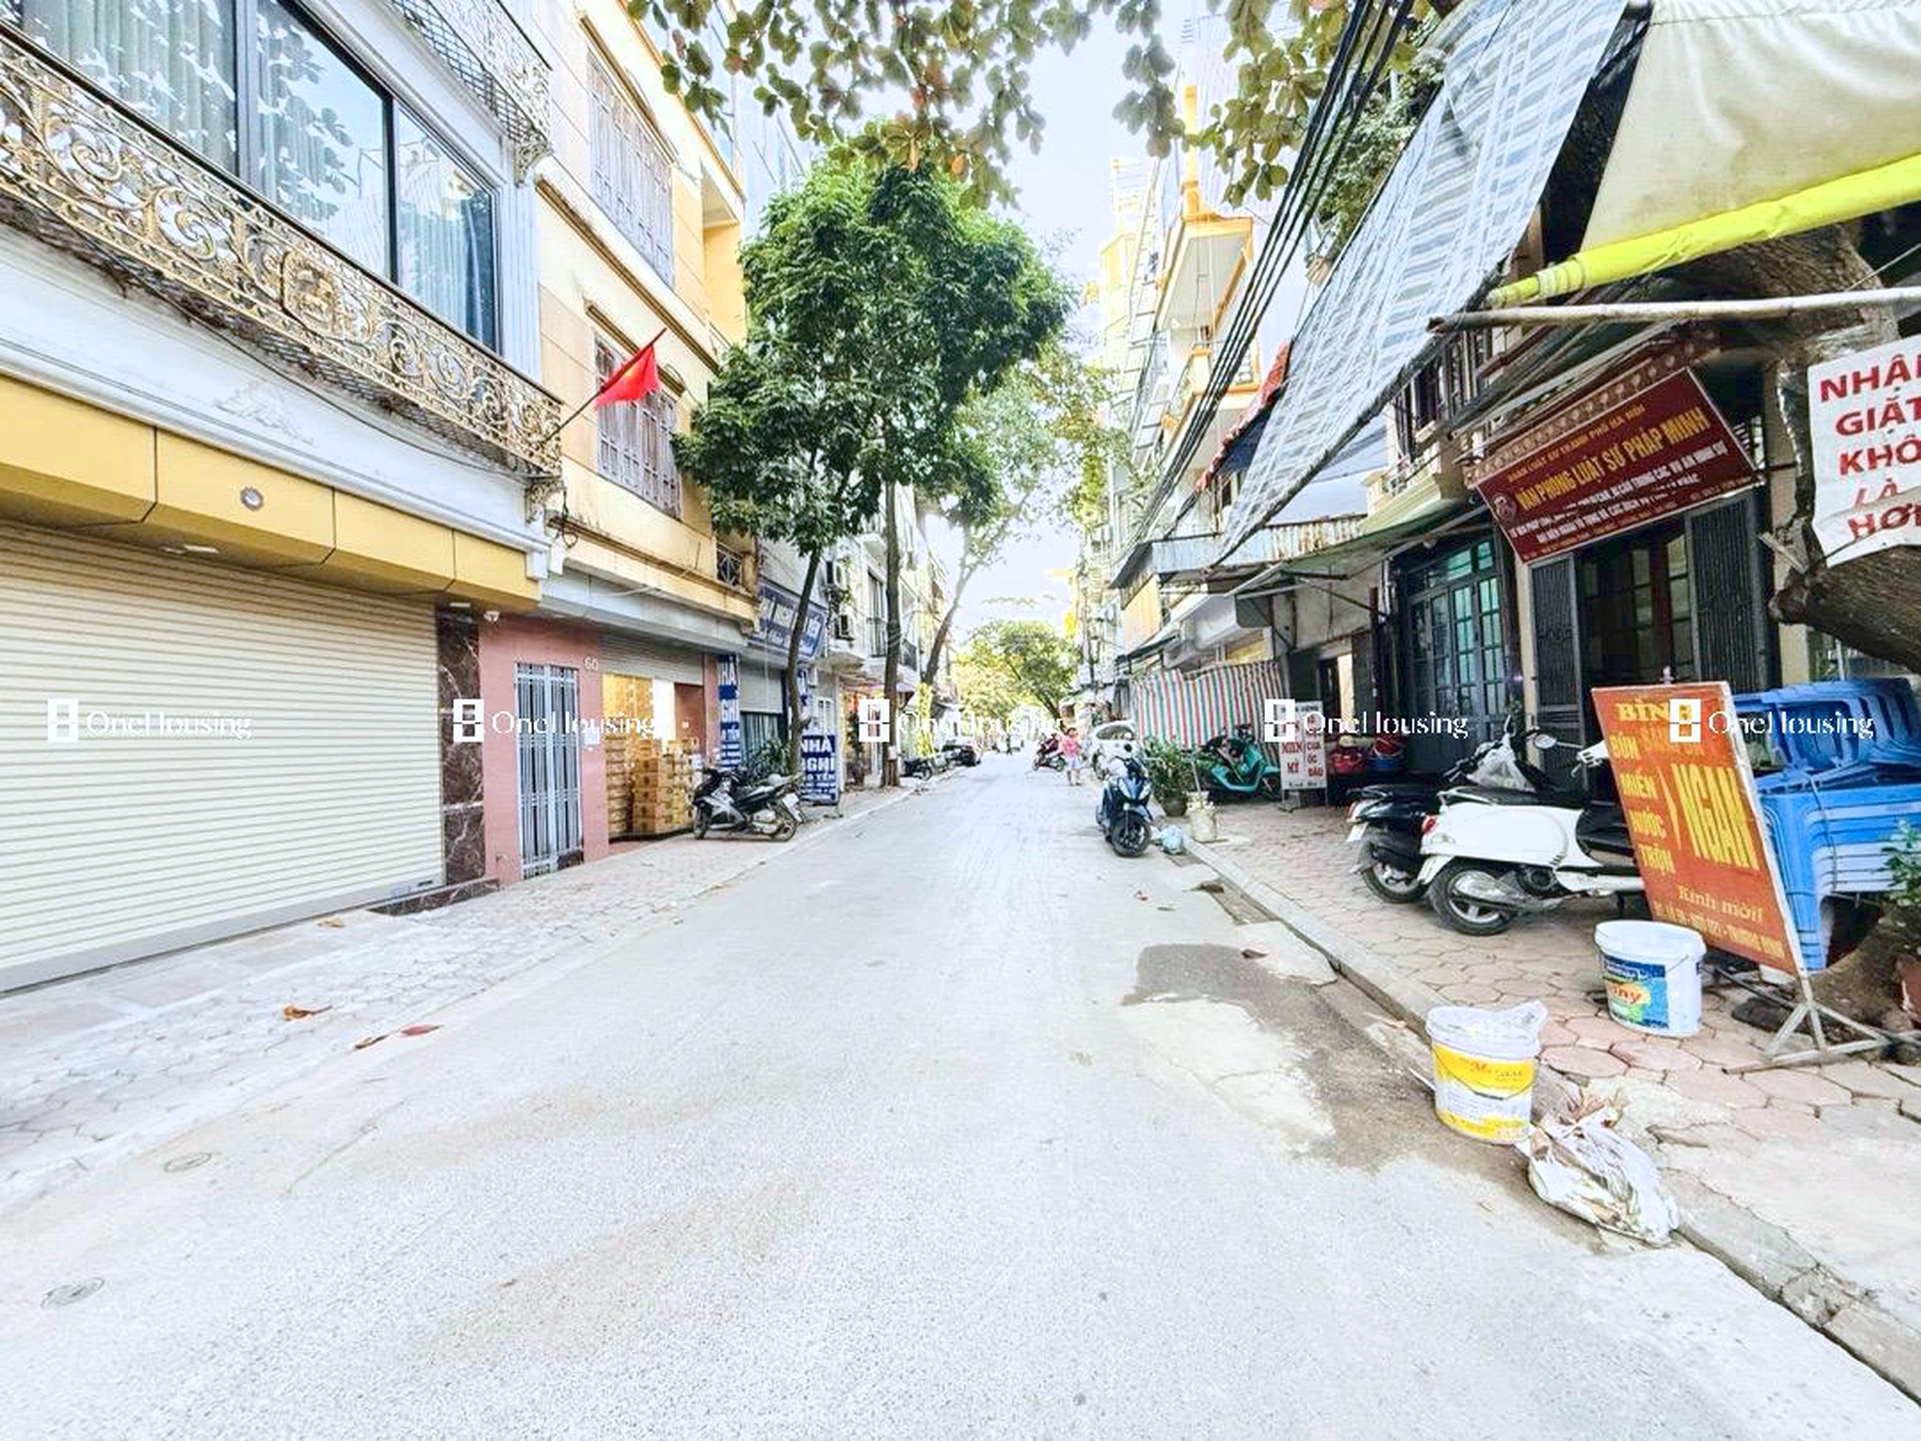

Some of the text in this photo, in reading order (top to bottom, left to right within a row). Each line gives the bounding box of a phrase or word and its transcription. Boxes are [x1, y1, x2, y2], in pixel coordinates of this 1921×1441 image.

[1820, 354, 1921, 403] NHẬ
[1570, 455, 1607, 484] LUẬT
[1601, 442, 1626, 472] SƯ
[1621, 426, 1665, 462] PHÁP
[1659, 406, 1712, 445] MINH
[1670, 763, 1762, 871] NGAN
